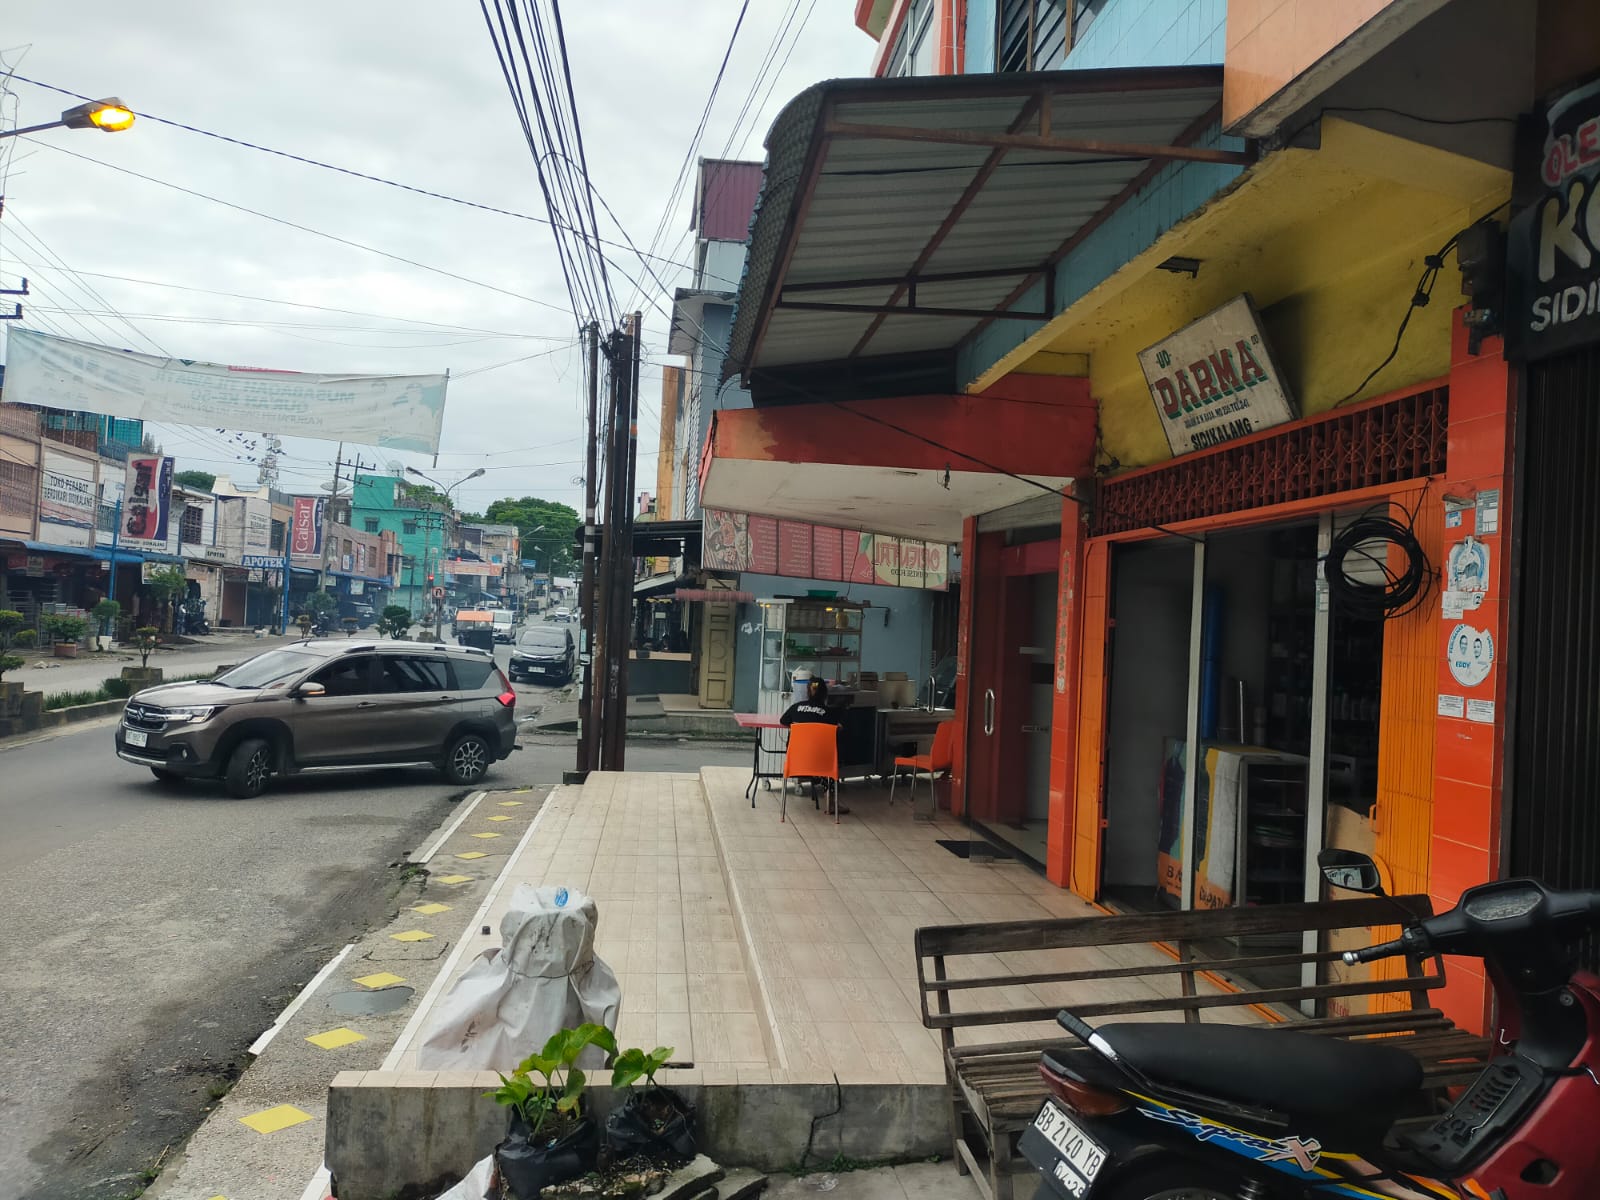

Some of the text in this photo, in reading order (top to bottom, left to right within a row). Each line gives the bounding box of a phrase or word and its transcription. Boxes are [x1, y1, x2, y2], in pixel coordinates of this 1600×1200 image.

[1530, 278, 1600, 332] SIDI
[1191, 417, 1253, 449] SIDIKALANG
[50, 476, 64, 489] TOKO
[295, 503, 311, 552] Caisar
[243, 556, 285, 568] APOTEK
[1037, 1106, 1101, 1177] BB 2140 YB
[1136, 1107, 1322, 1172] Supra X
